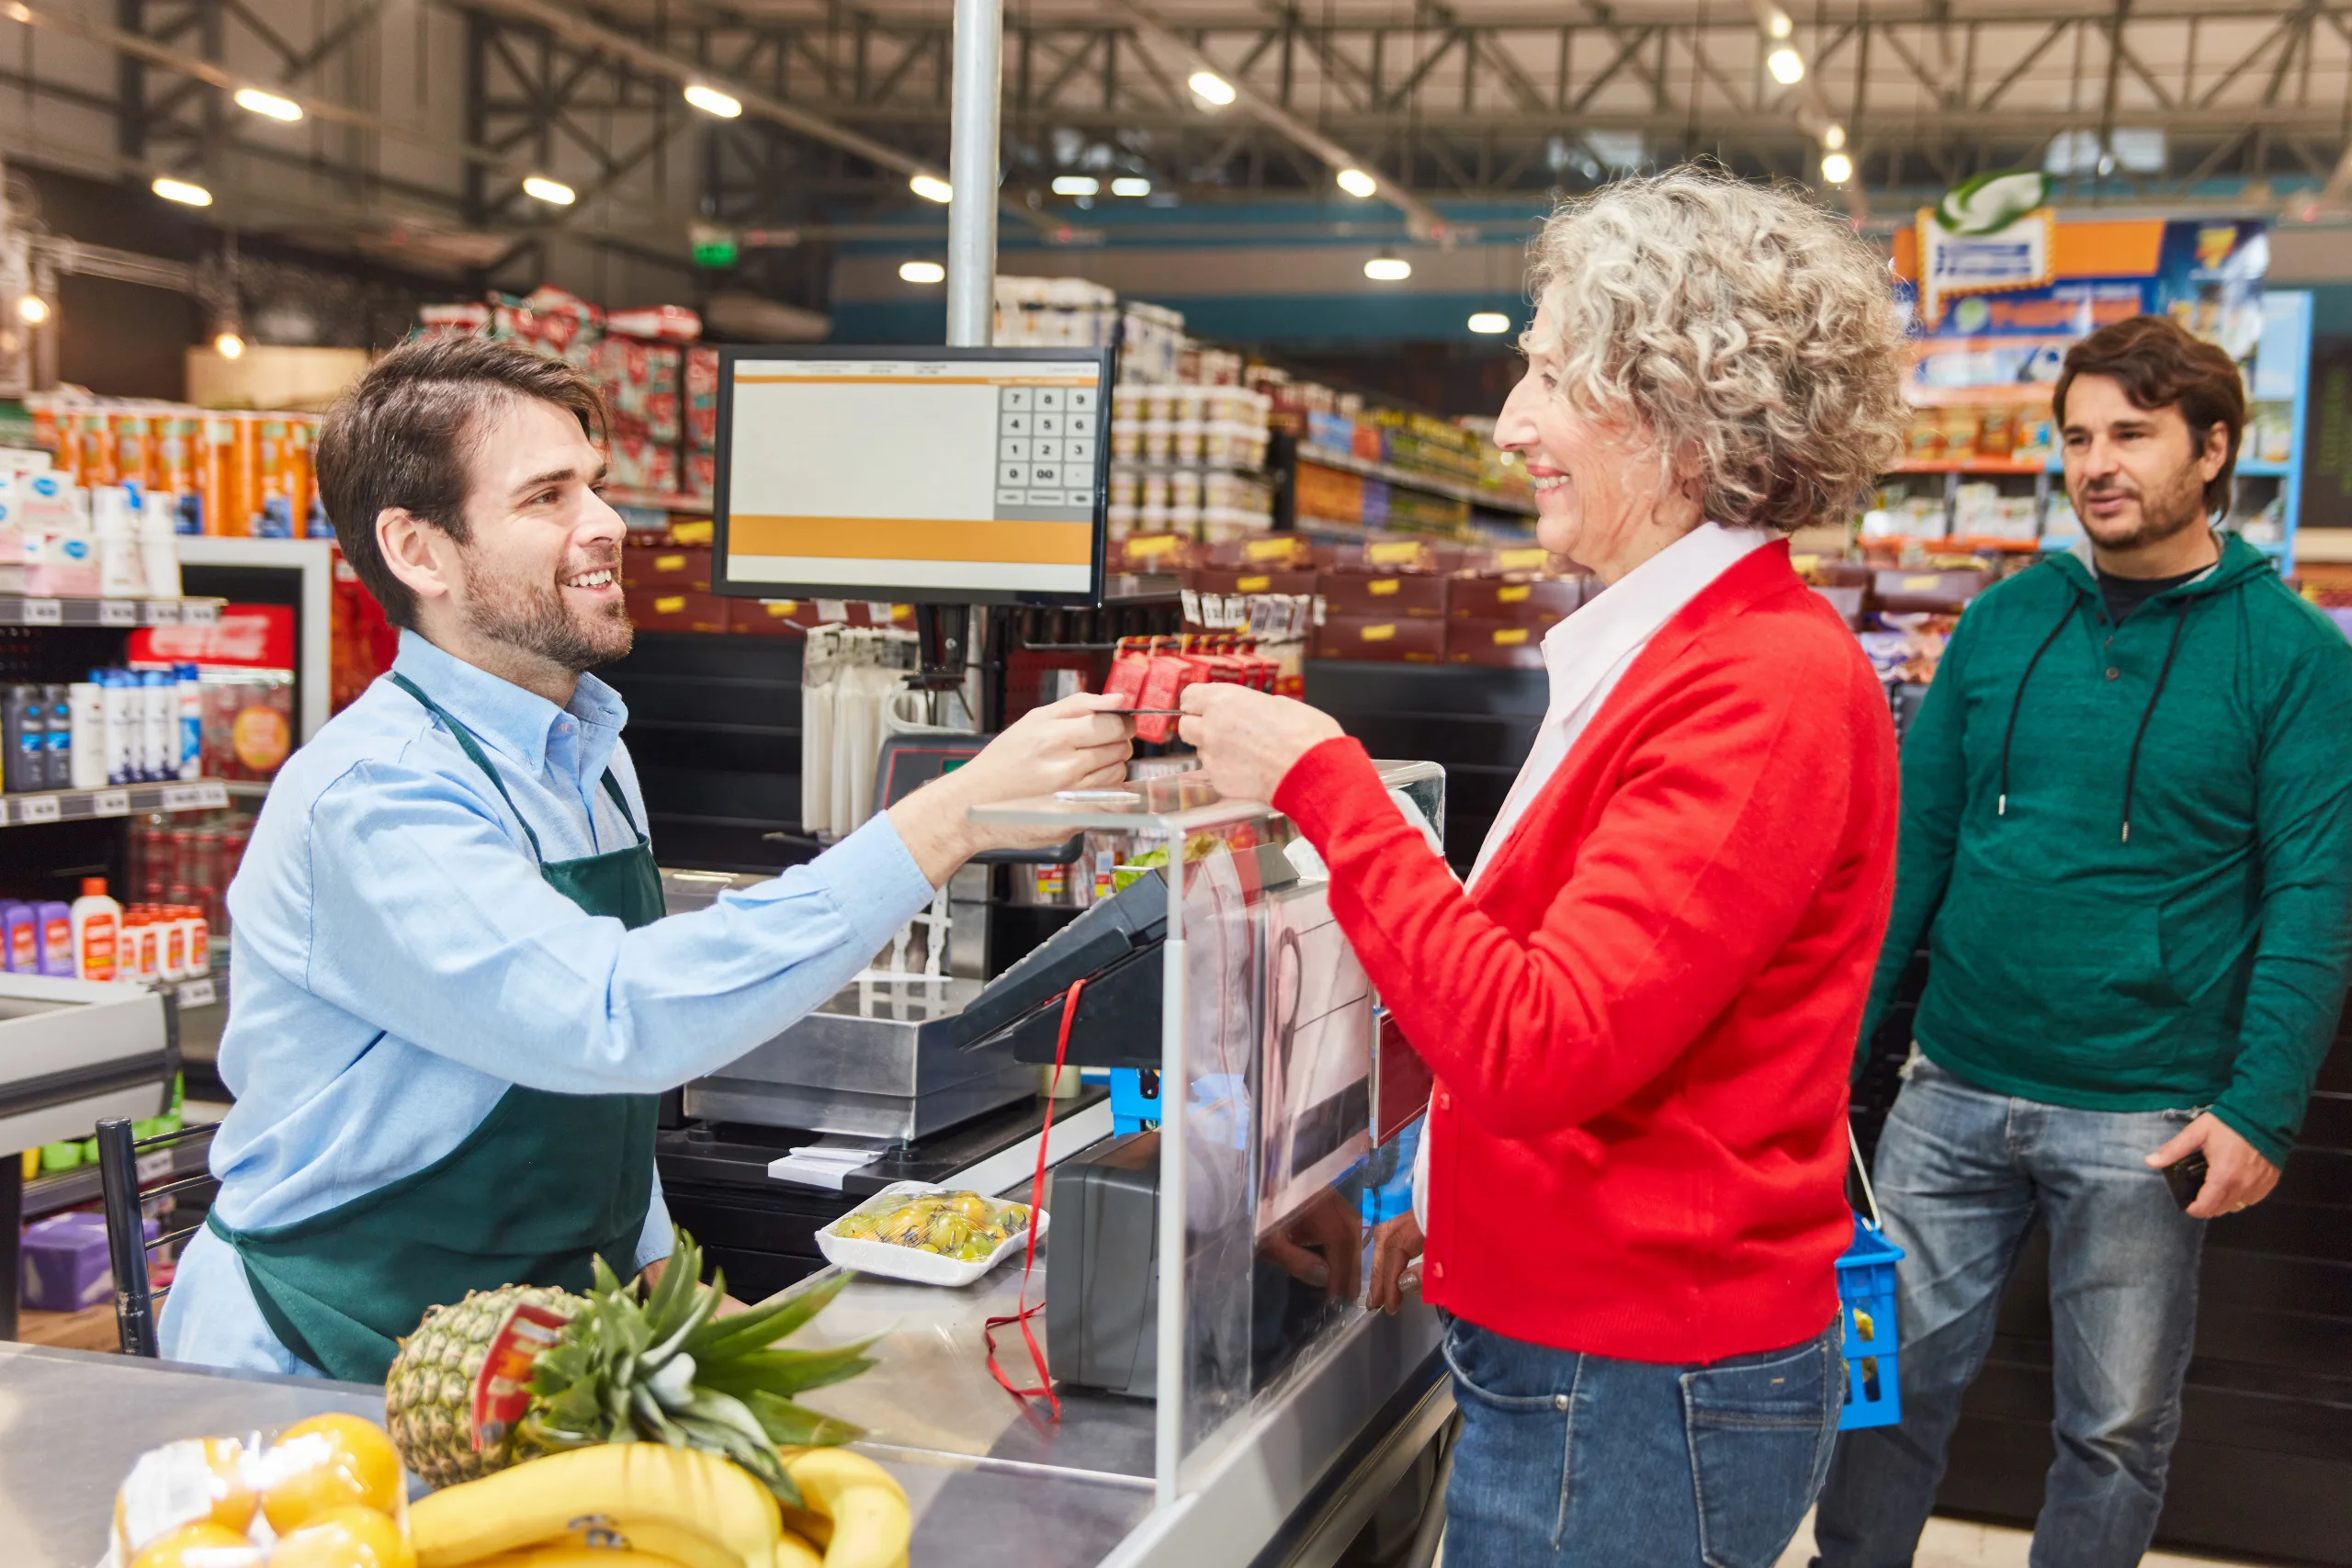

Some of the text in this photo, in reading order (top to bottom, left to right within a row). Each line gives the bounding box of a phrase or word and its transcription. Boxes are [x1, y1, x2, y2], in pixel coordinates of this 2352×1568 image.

[1076, 394, 1086, 405] 9
[1010, 419, 1084, 431] 4 5 6
[1042, 444, 1051, 456] 2
[1074, 444, 1083, 456] 3
[1009, 468, 1055, 480] 0 00
